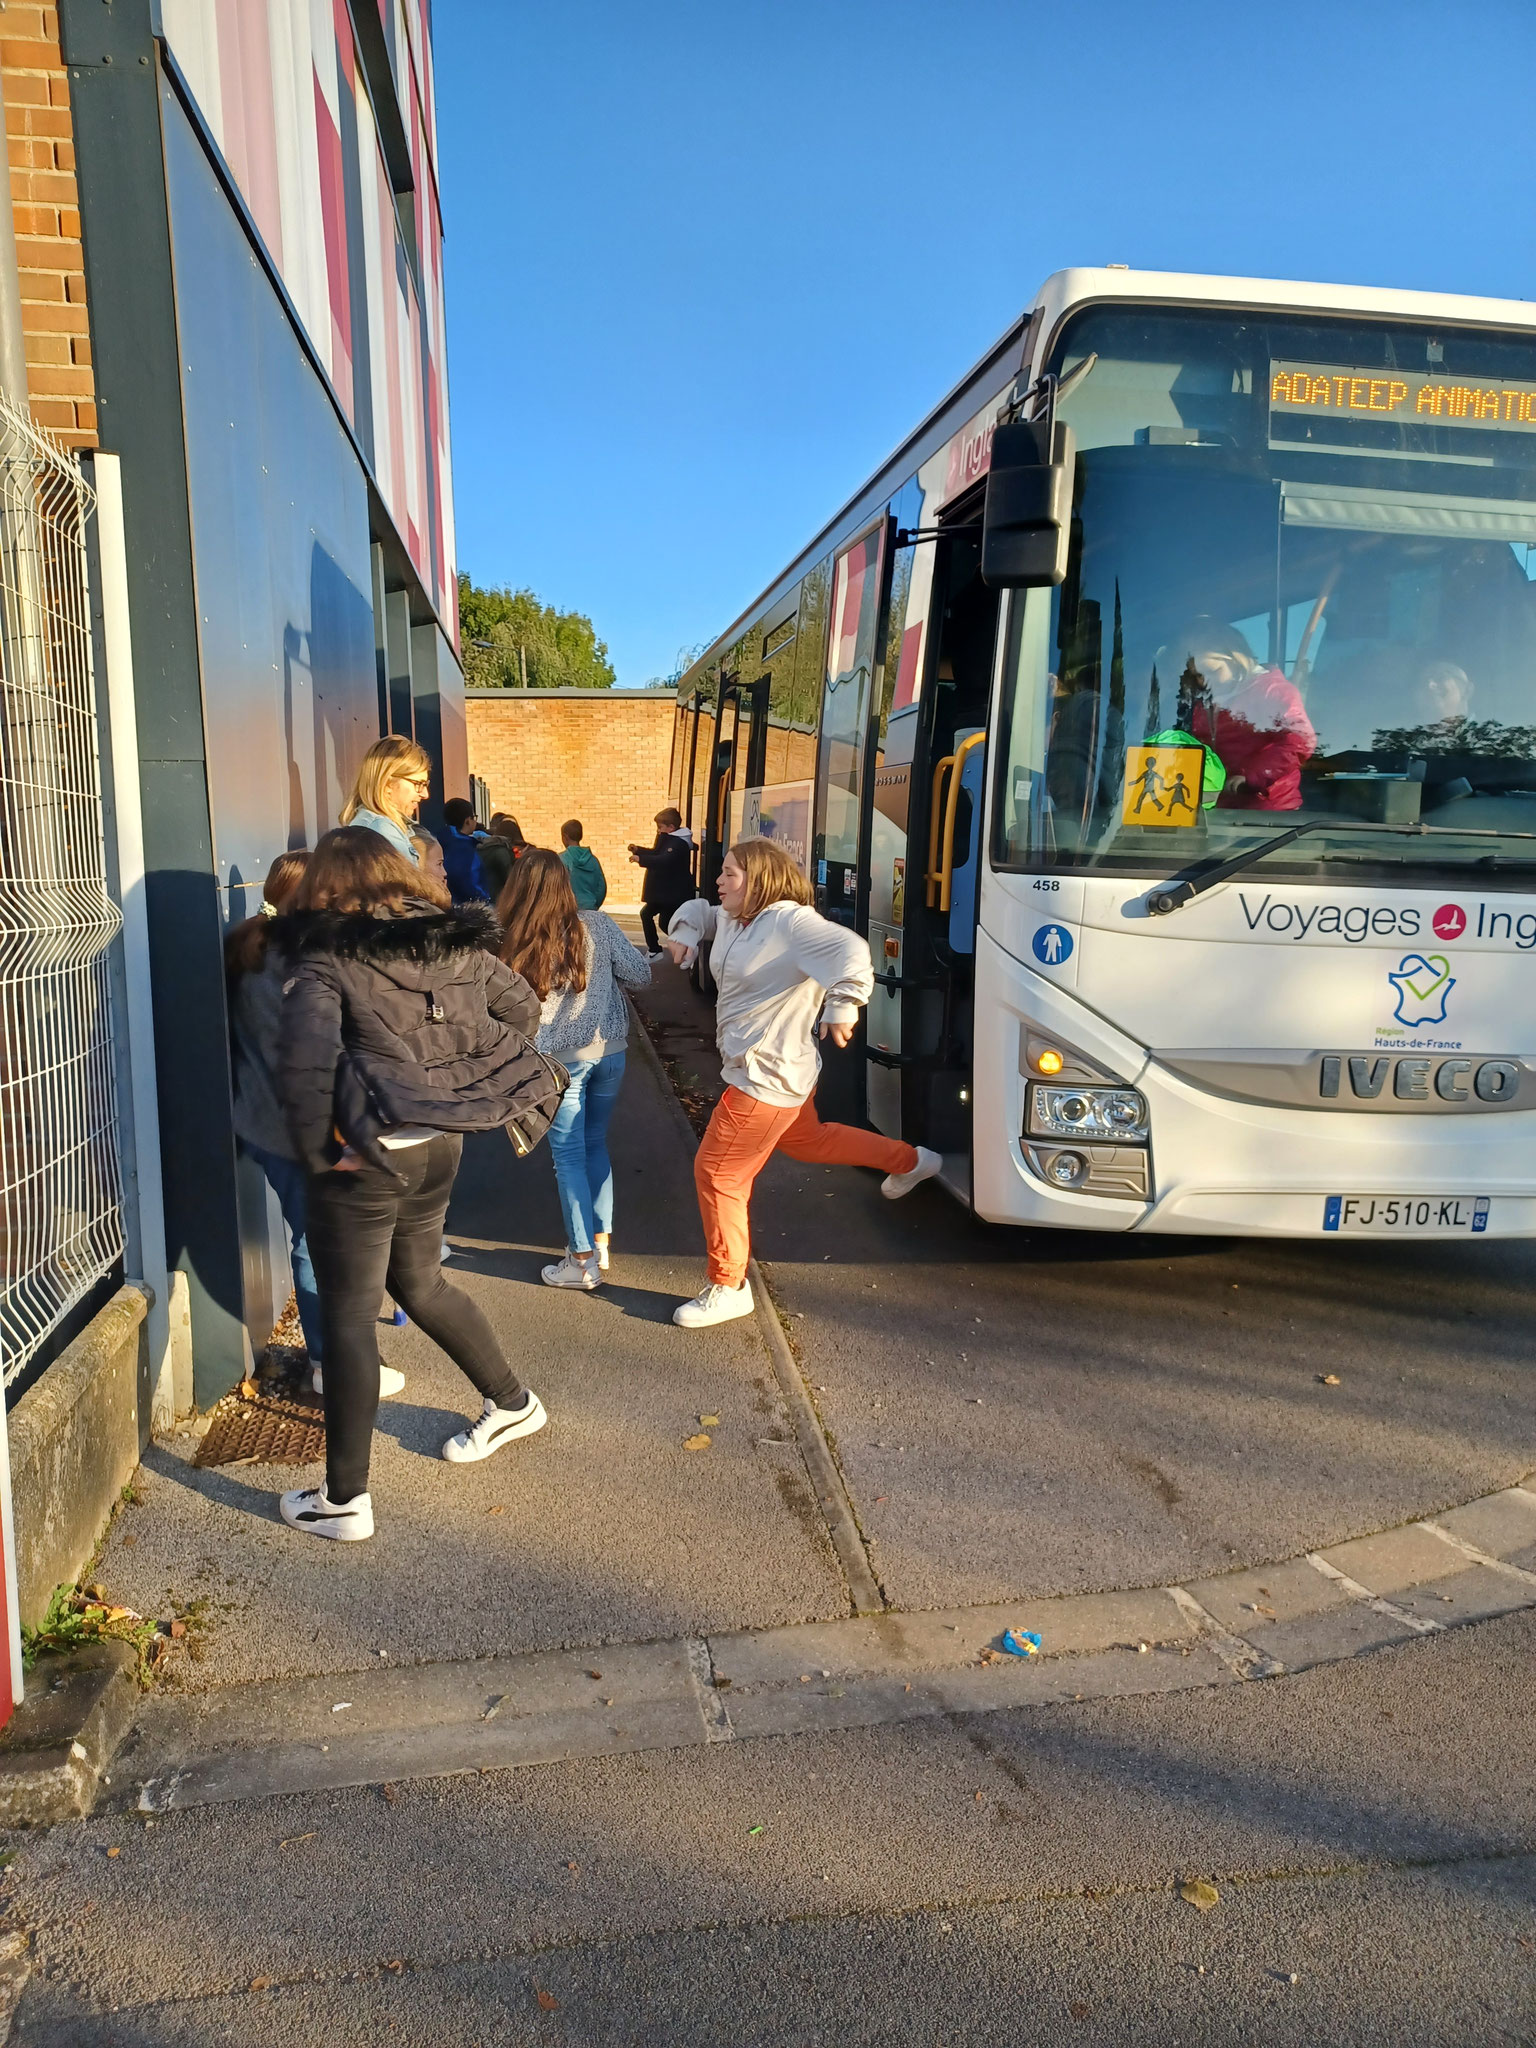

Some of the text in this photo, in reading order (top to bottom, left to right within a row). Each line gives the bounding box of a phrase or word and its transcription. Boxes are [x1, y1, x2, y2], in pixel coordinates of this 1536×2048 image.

[1272, 371, 1408, 412] ADATEEP
[1033, 879, 1060, 892] 458
[1239, 892, 1421, 942] Voyages
[1374, 1037, 1462, 1049] Hauts-de-France
[1319, 1056, 1521, 1102] IVECO
[1343, 1200, 1467, 1226] FJ-510-KL
[1474, 1215, 1486, 1227] 62
